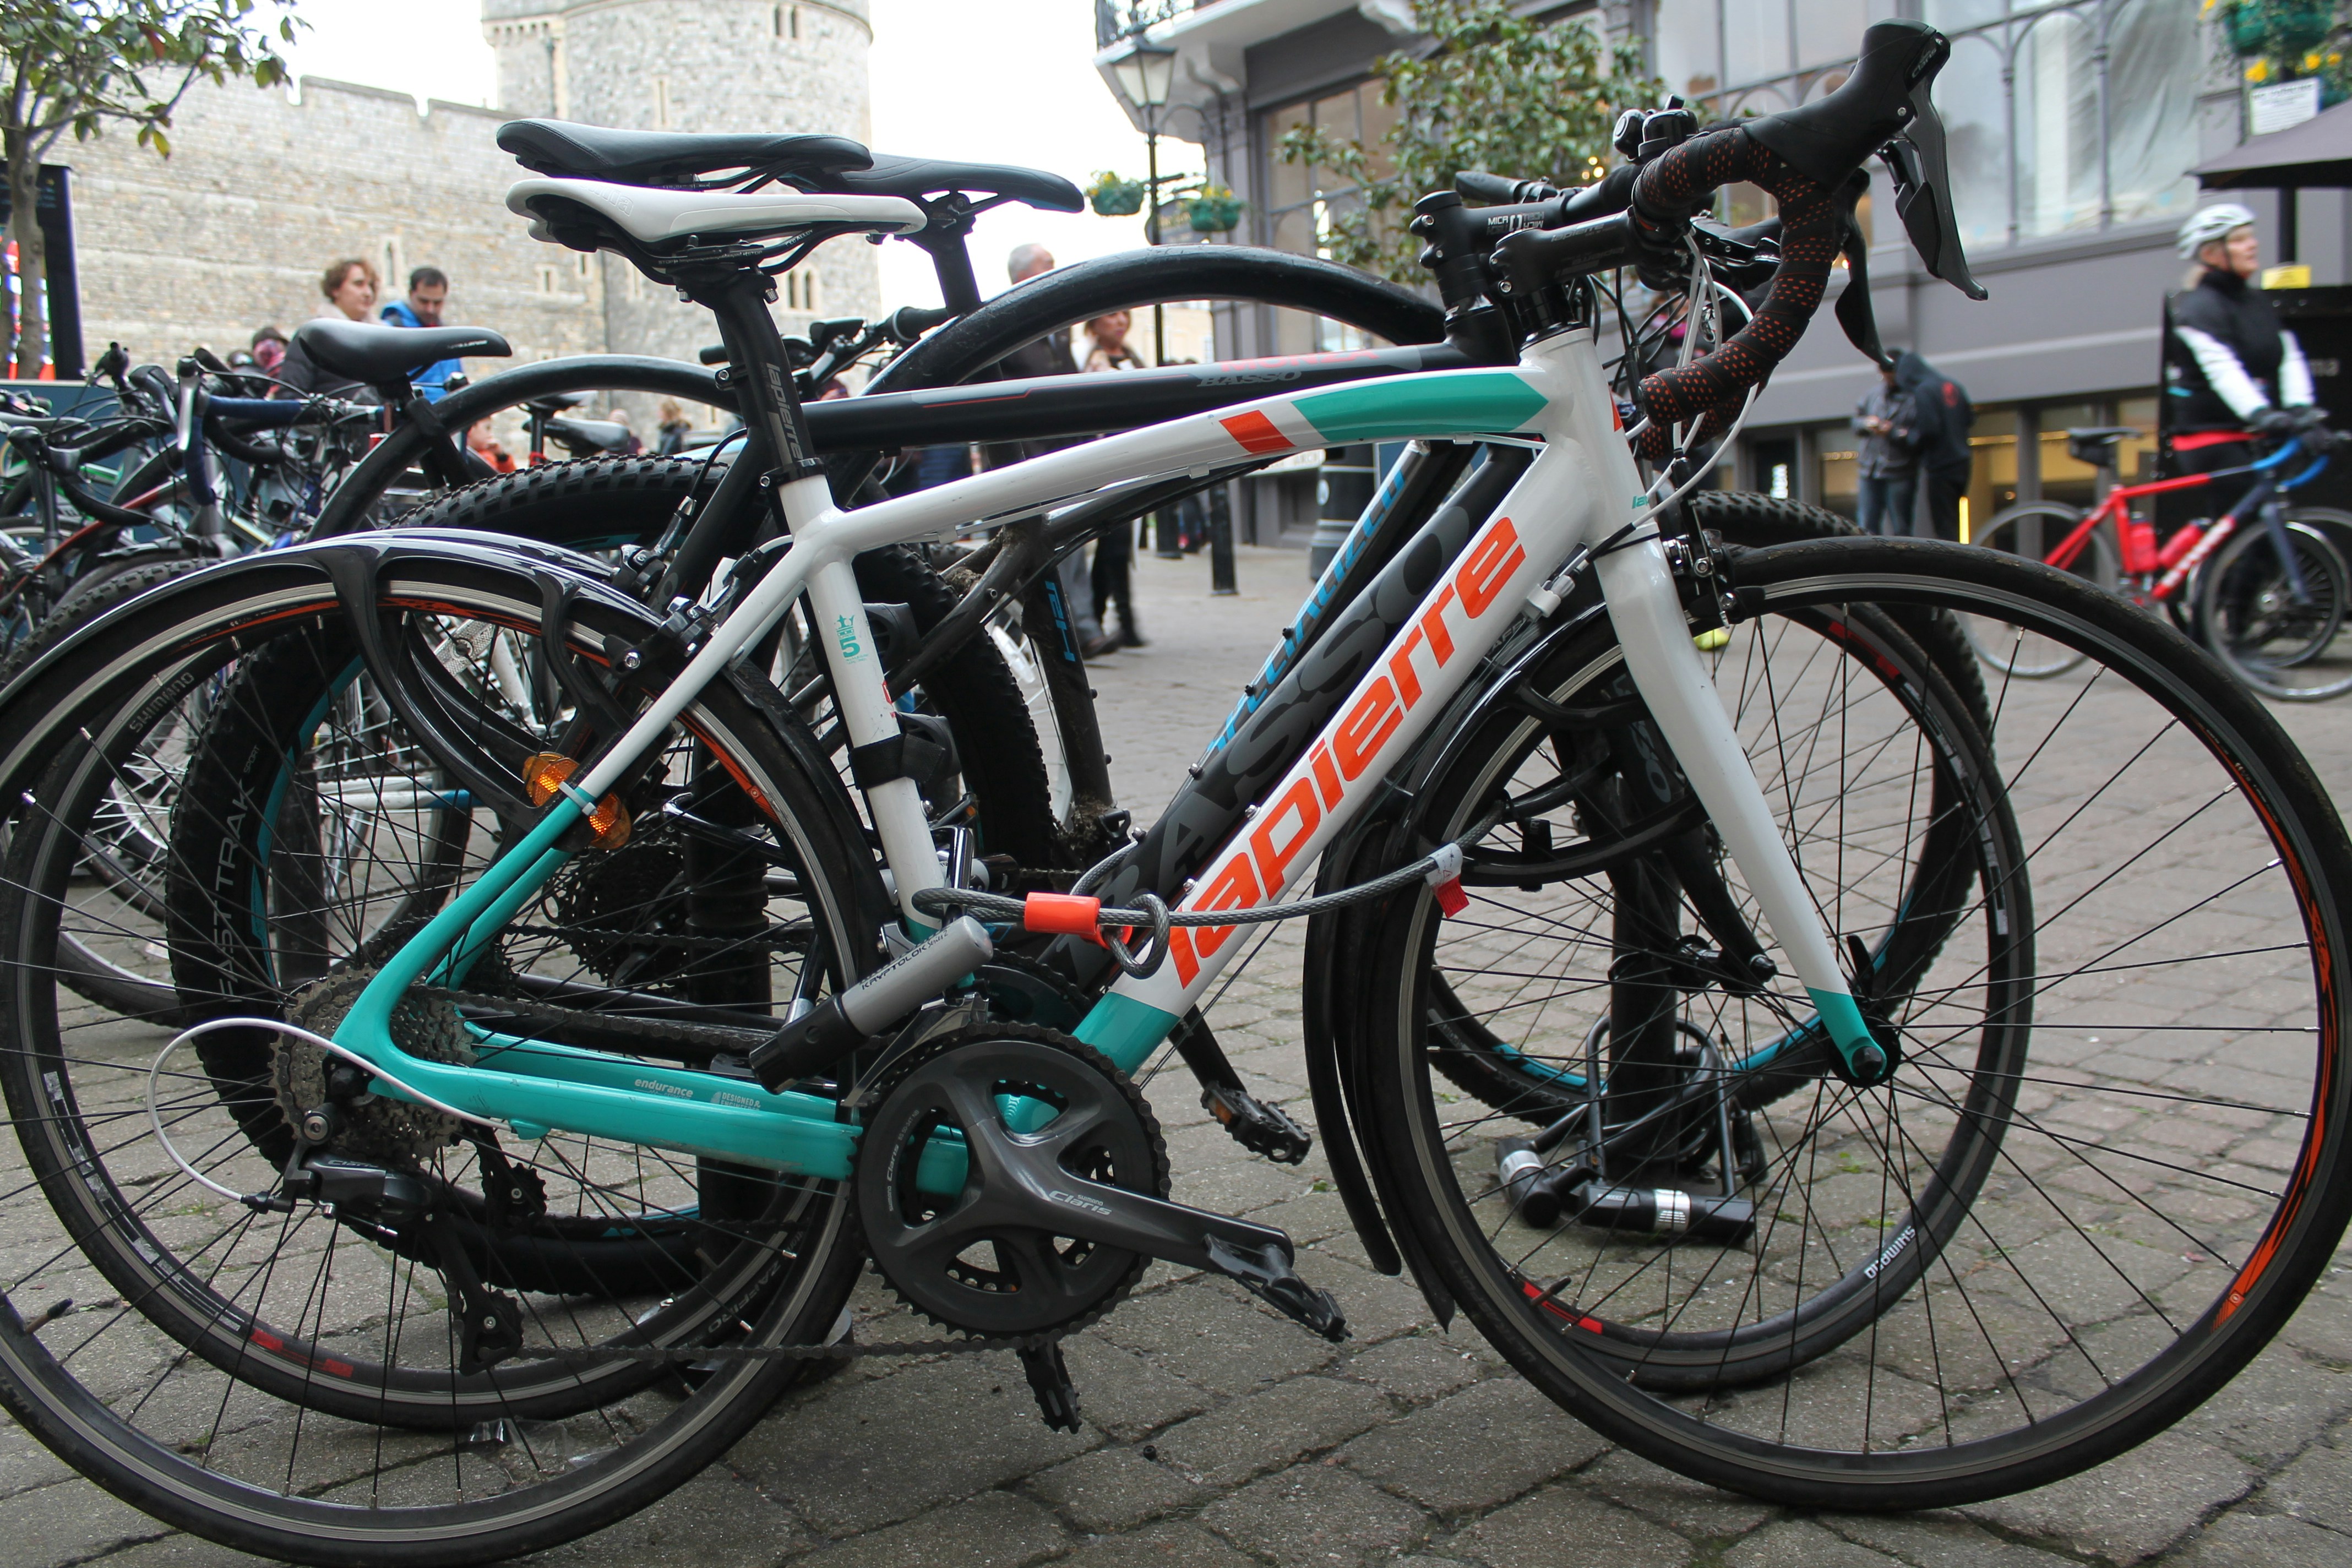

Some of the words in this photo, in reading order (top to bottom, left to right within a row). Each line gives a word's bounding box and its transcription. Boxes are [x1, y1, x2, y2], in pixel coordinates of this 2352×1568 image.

[1197, 371, 1302, 387] BASSO
[766, 362, 803, 460] lapierre
[839, 635, 861, 658] 5
[129, 672, 194, 733] SHIMANO
[244, 744, 261, 774] SPORT
[1168, 516, 1526, 990] lapierre
[215, 777, 255, 891] TRAK
[214, 899, 243, 1004] FAST
[862, 945, 928, 990] KRYPTOLOK
[928, 935, 945, 949] Series
[634, 1077, 694, 1098] endurance
[722, 1092, 754, 1107] DESIGNED
[754, 1099, 761, 1109] &
[887, 1144, 900, 1182] Claris
[1048, 1190, 1112, 1216] Claris
[1077, 1194, 1104, 1207] SHIMANO
[1864, 1226, 1916, 1280] SHIMANO
[707, 1260, 782, 1333] ZAFFIRO
